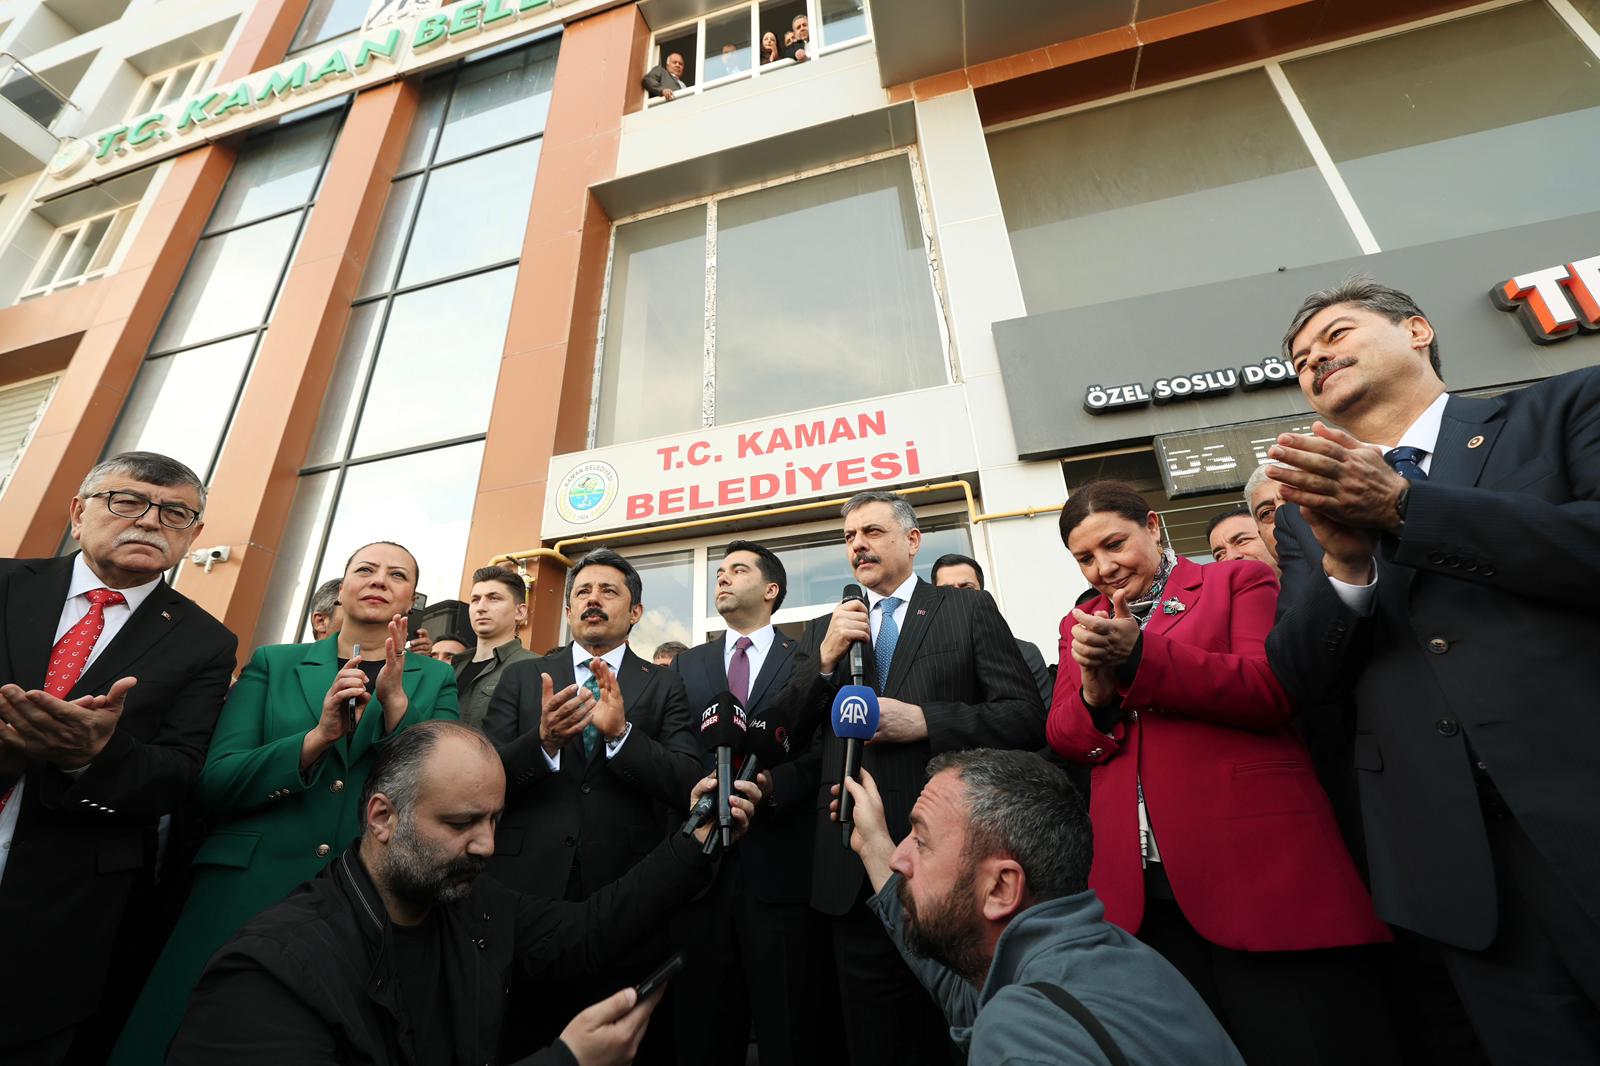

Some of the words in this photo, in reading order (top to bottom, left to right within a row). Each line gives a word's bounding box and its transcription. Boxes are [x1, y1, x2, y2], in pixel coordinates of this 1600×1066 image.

[95, 113, 167, 160] T.C.
[176, 29, 399, 131] KAMAN
[1087, 386, 1149, 407] ÖZEL
[1155, 369, 1237, 396] SOSLU
[657, 441, 723, 471] T.C.
[737, 410, 887, 458] KAMAN
[626, 440, 920, 520] BELEDİYESİ
[840, 703, 867, 725] AA
